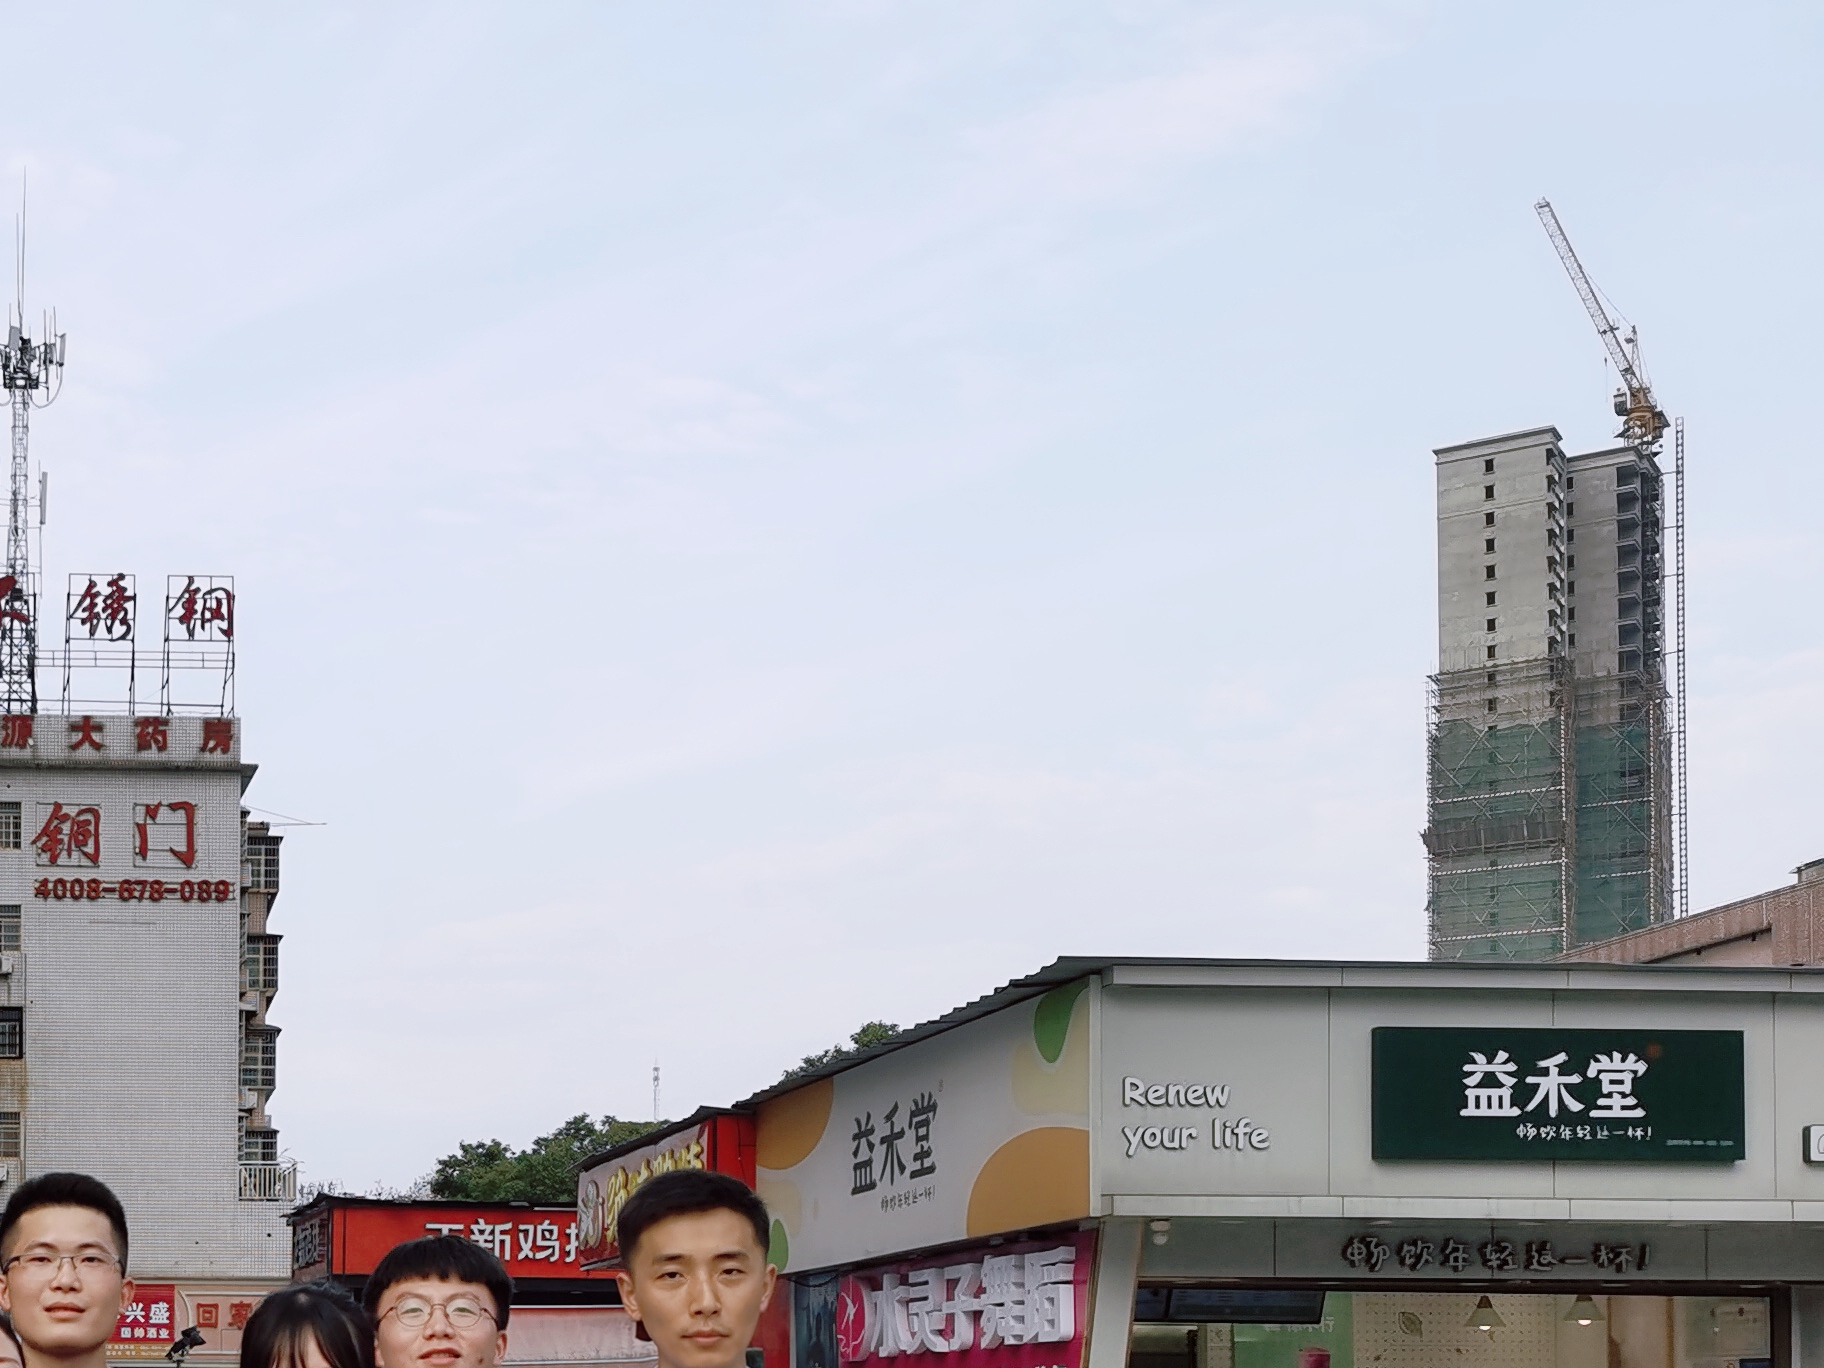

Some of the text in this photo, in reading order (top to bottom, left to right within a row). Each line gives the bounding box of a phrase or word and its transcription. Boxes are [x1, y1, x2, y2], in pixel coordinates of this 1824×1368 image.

[35, 877, 232, 902] 4008-678-089
[1123, 1077, 1230, 1107] Renew
[1460, 1050, 1650, 1119] 益禾堂
[850, 1091, 938, 1196] 益禾堂
[1122, 1117, 1270, 1157] your life
[118, 1301, 170, 1324] 兴盛
